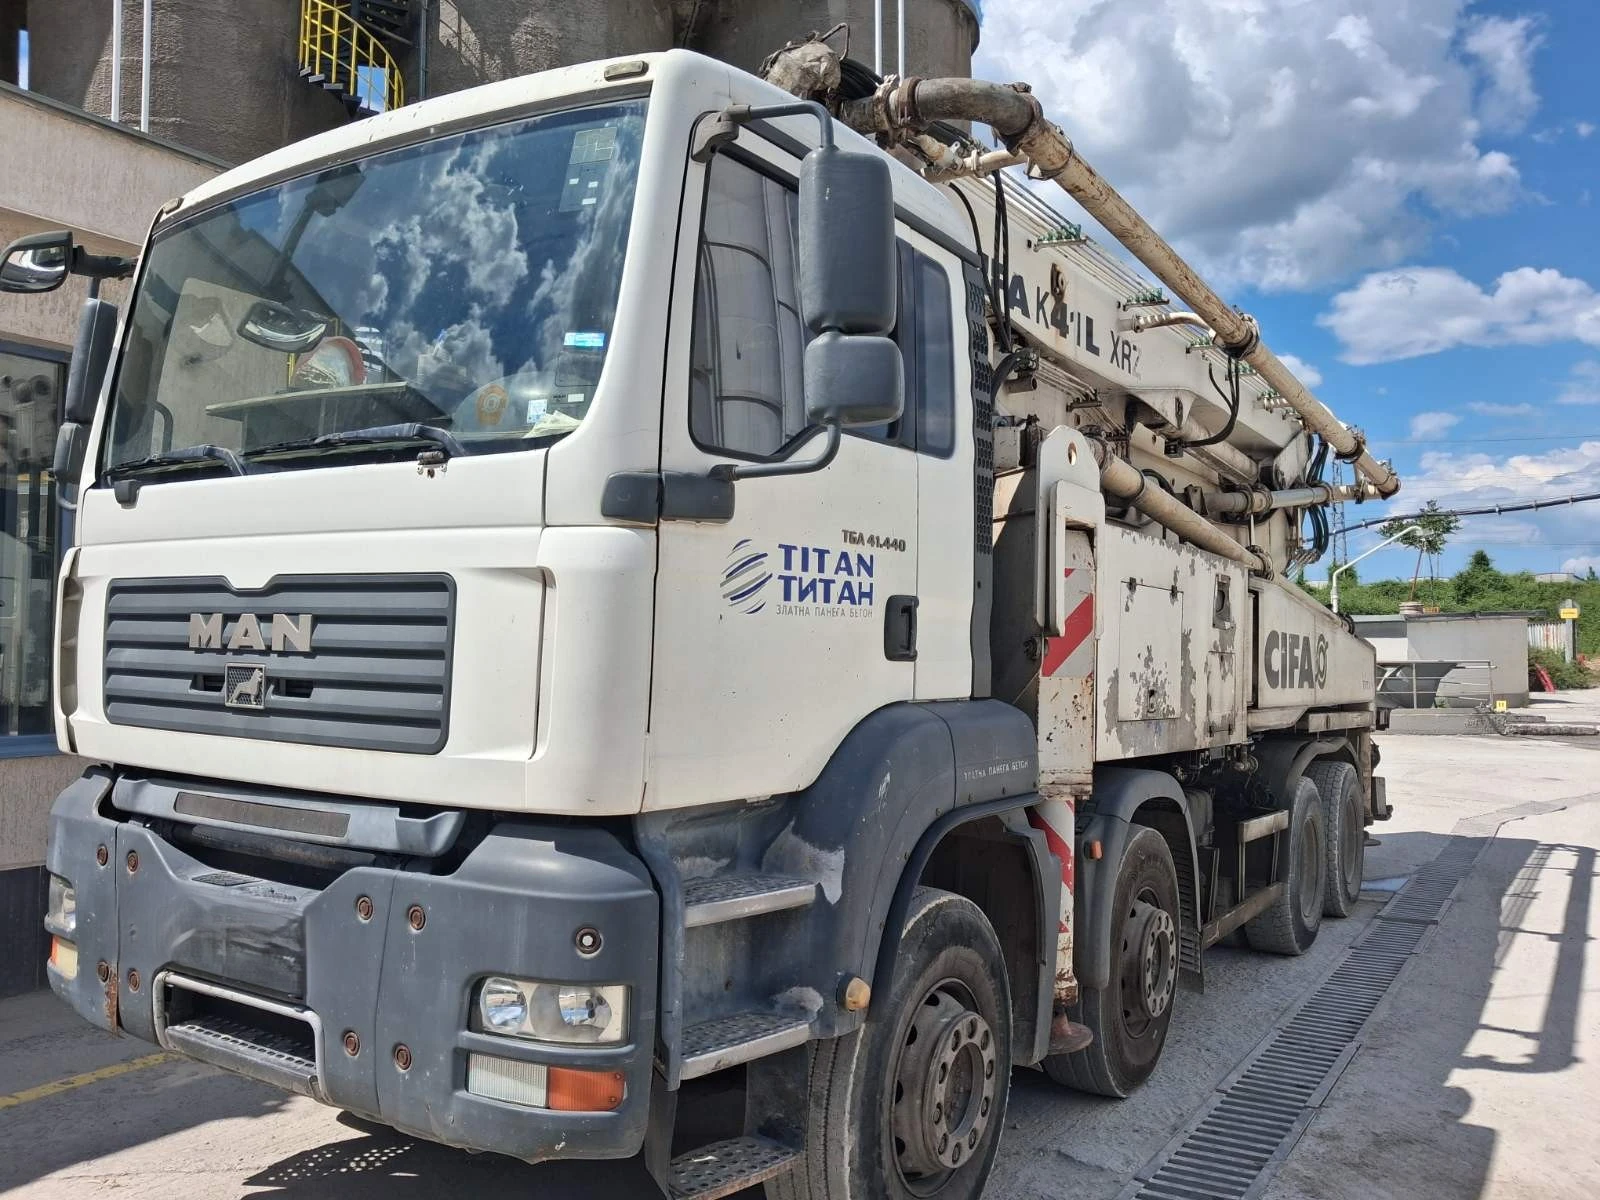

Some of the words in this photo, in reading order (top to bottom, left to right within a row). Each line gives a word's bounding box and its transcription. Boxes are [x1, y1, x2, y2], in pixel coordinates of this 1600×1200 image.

[867, 534, 906, 552] 41.440
[778, 543, 874, 578] TITAN
[777, 574, 873, 606] ТИТАН
[776, 604, 811, 617] ЗЛАТНА
[814, 606, 846, 617] ПАНЕГА
[849, 607, 873, 618] БЕТОН
[189, 613, 312, 651] MAN
[1264, 630, 1315, 689] CIFA
